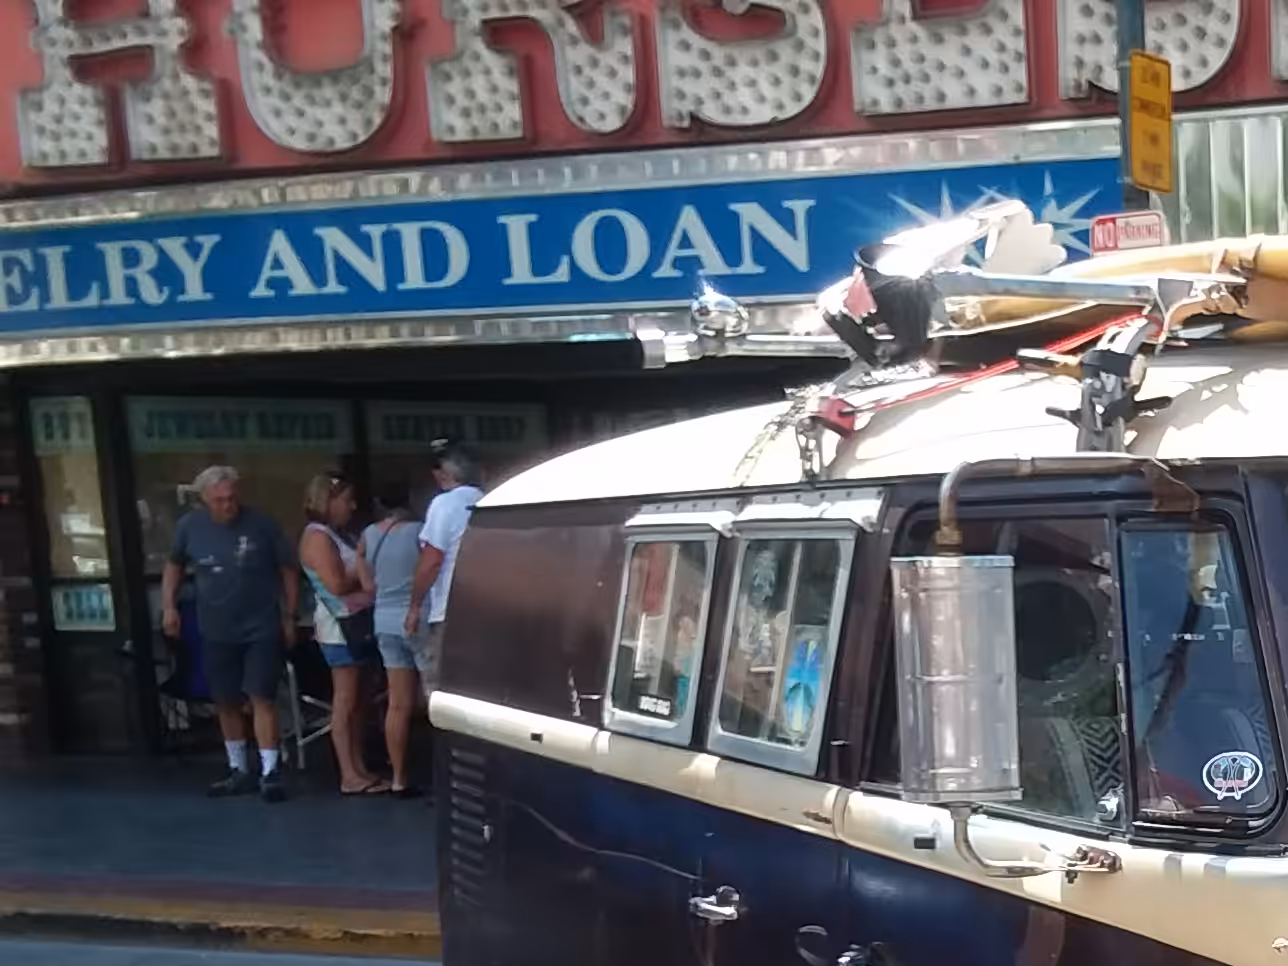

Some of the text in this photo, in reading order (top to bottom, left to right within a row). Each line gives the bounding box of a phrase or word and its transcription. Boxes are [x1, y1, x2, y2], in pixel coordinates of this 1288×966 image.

[0, 199, 817, 312] ELRY AND LOAN
[1094, 221, 1117, 249] NO
